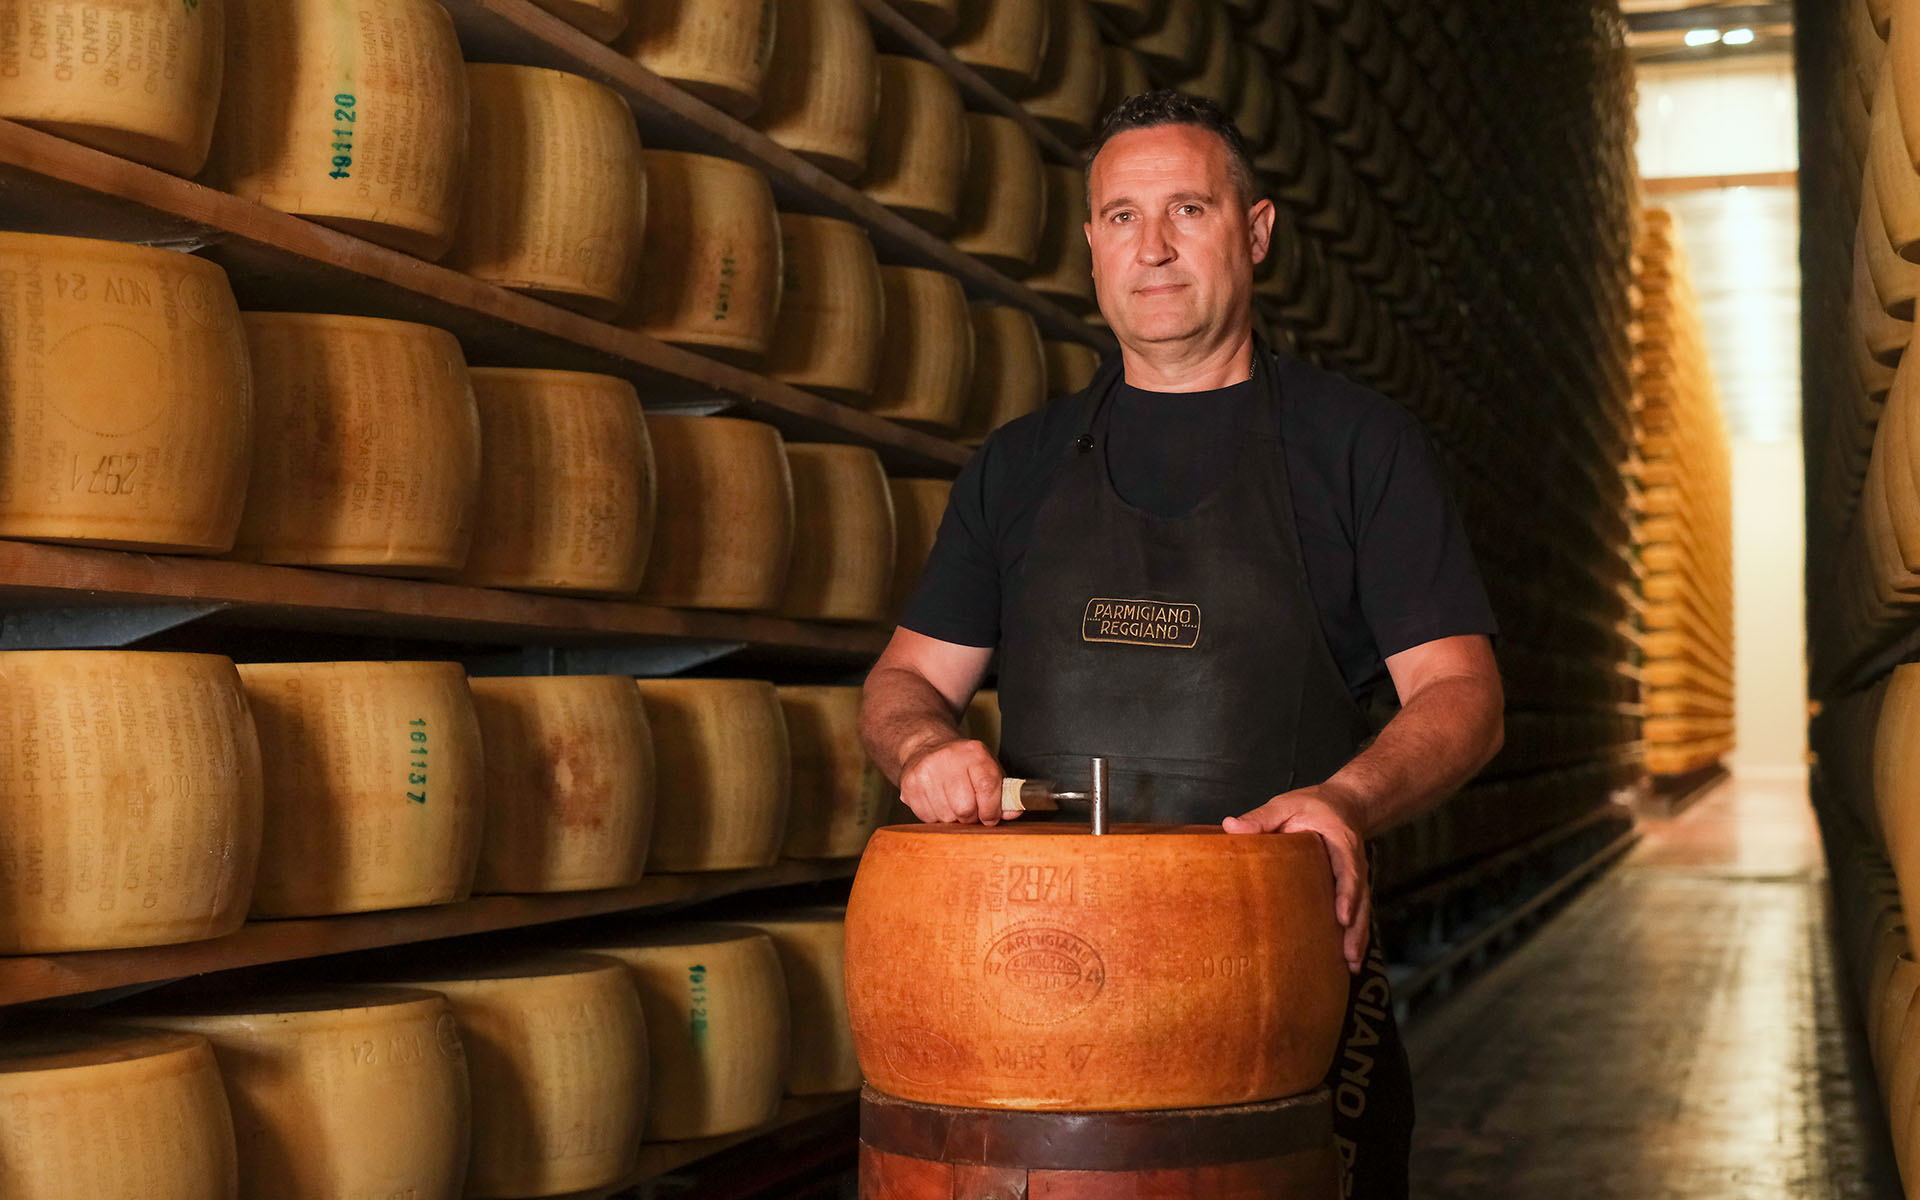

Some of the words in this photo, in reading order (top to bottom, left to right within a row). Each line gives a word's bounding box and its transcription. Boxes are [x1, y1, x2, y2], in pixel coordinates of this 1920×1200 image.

[329, 93, 357, 181] 191120
[1094, 603, 1192, 625] PARMIGIANO
[1100, 620, 1179, 641] REGGIANO
[406, 716, 430, 806] 161137
[1007, 865, 1076, 904] 2971
[1201, 955, 1249, 978] DOP
[993, 1044, 1046, 1071] MAR
